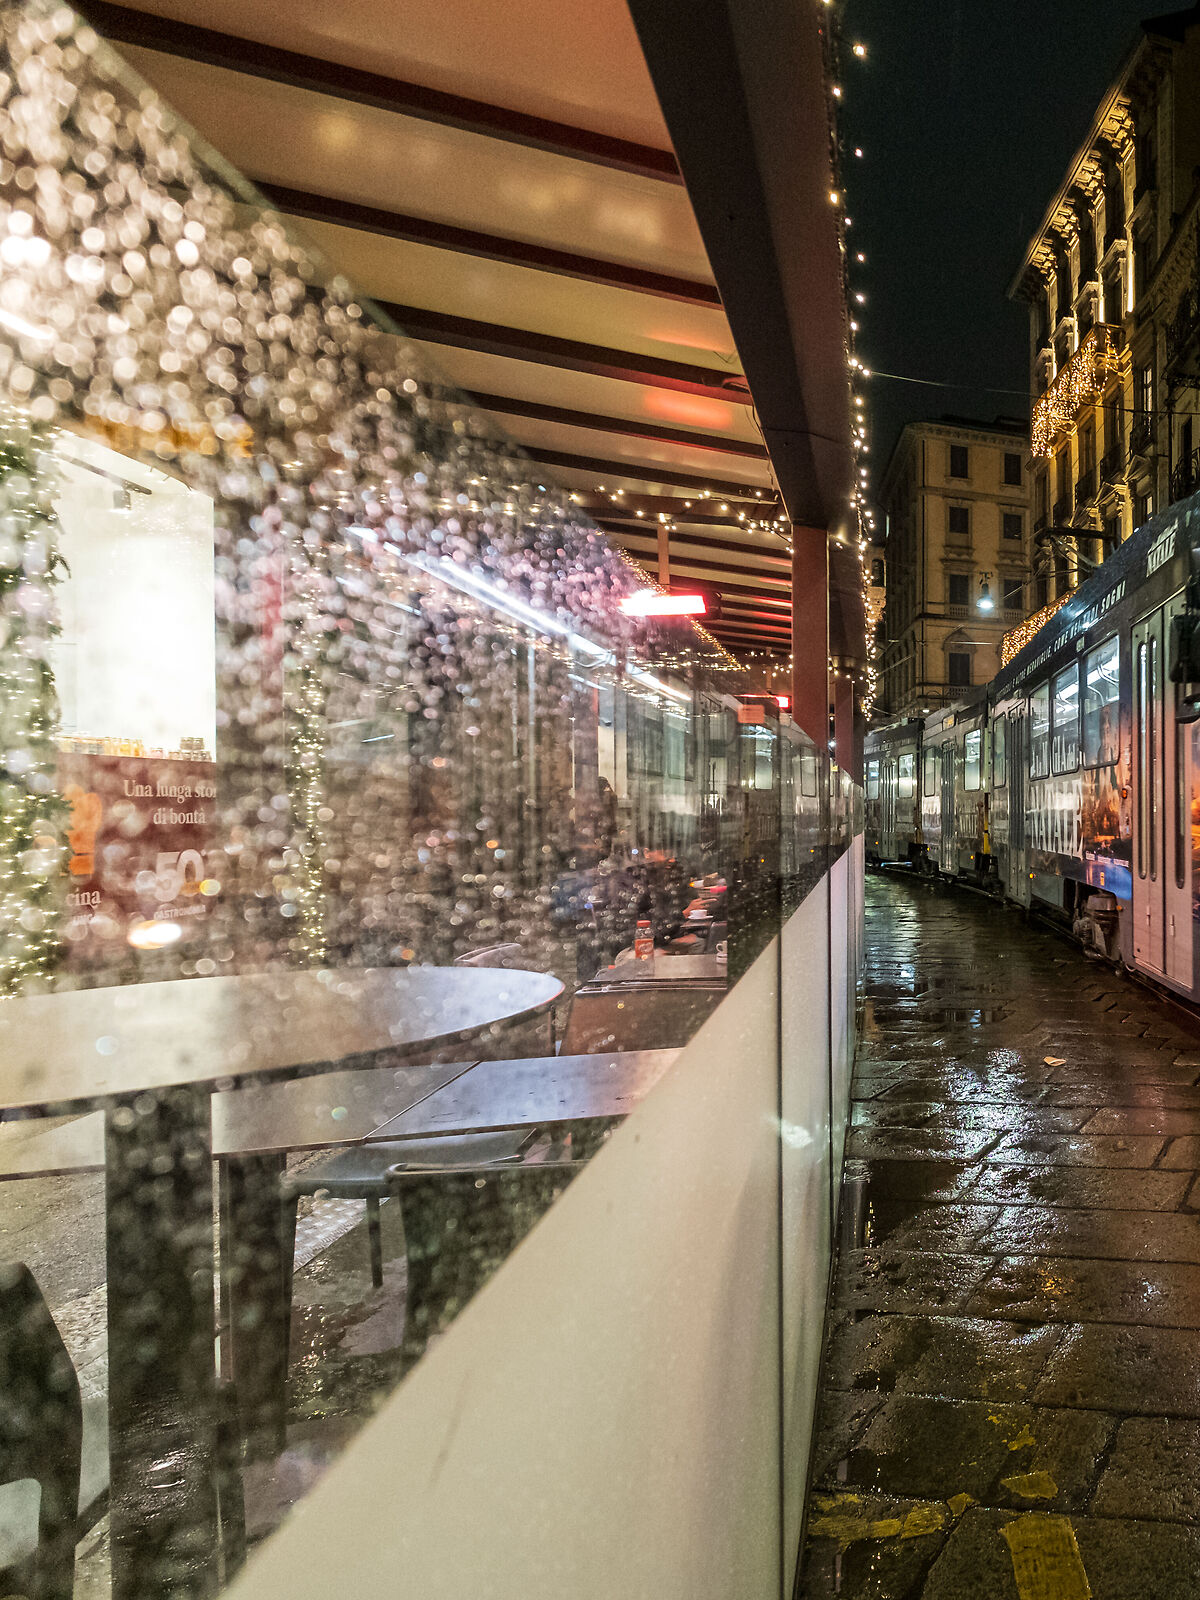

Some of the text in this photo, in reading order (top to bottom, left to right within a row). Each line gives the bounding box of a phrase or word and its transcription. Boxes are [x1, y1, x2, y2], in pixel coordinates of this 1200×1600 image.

[1101, 580, 1126, 613] SOGNI
[124, 780, 153, 797] Una
[157, 780, 192, 803] lunga
[153, 808, 207, 825] di bontà
[1031, 778, 1083, 861] NATALE
